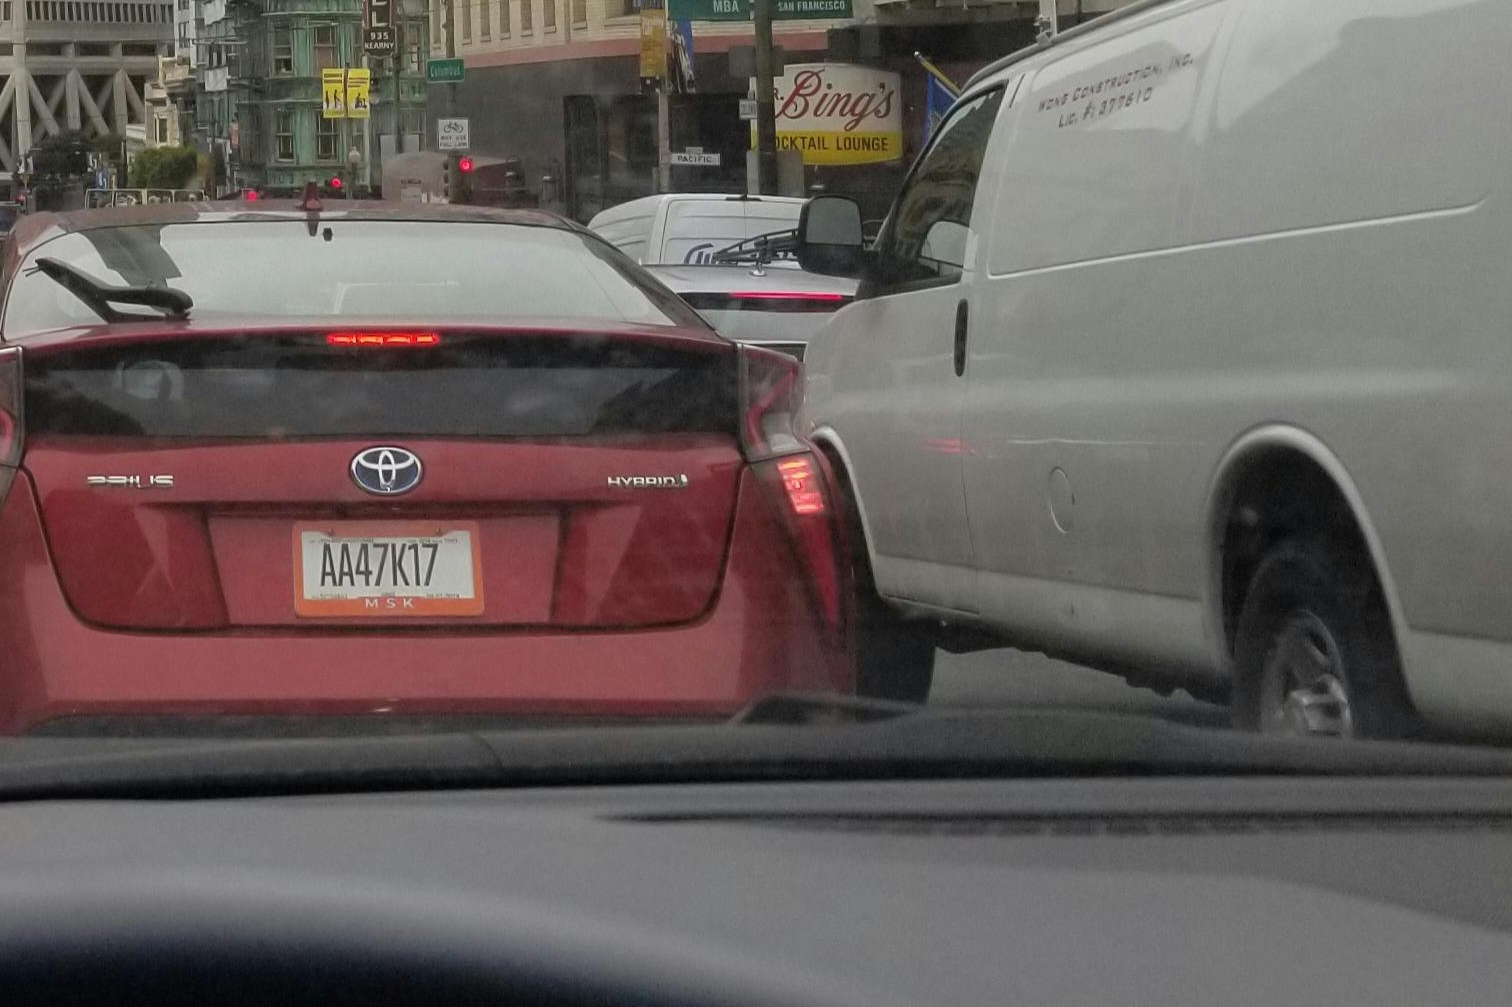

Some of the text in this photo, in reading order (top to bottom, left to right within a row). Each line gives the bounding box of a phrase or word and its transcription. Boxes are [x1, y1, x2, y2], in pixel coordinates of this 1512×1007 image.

[713, 0, 739, 13] MBA
[778, 0, 845, 11] SAN FRANCISCO
[370, 31, 389, 40] 935
[364, 41, 394, 50] KEARNY
[775, 69, 894, 132] Bing's
[776, 136, 889, 151] OCKTAIL LOUNGE
[677, 155, 712, 163] PACIFIC
[320, 543, 439, 587] AA47K17
